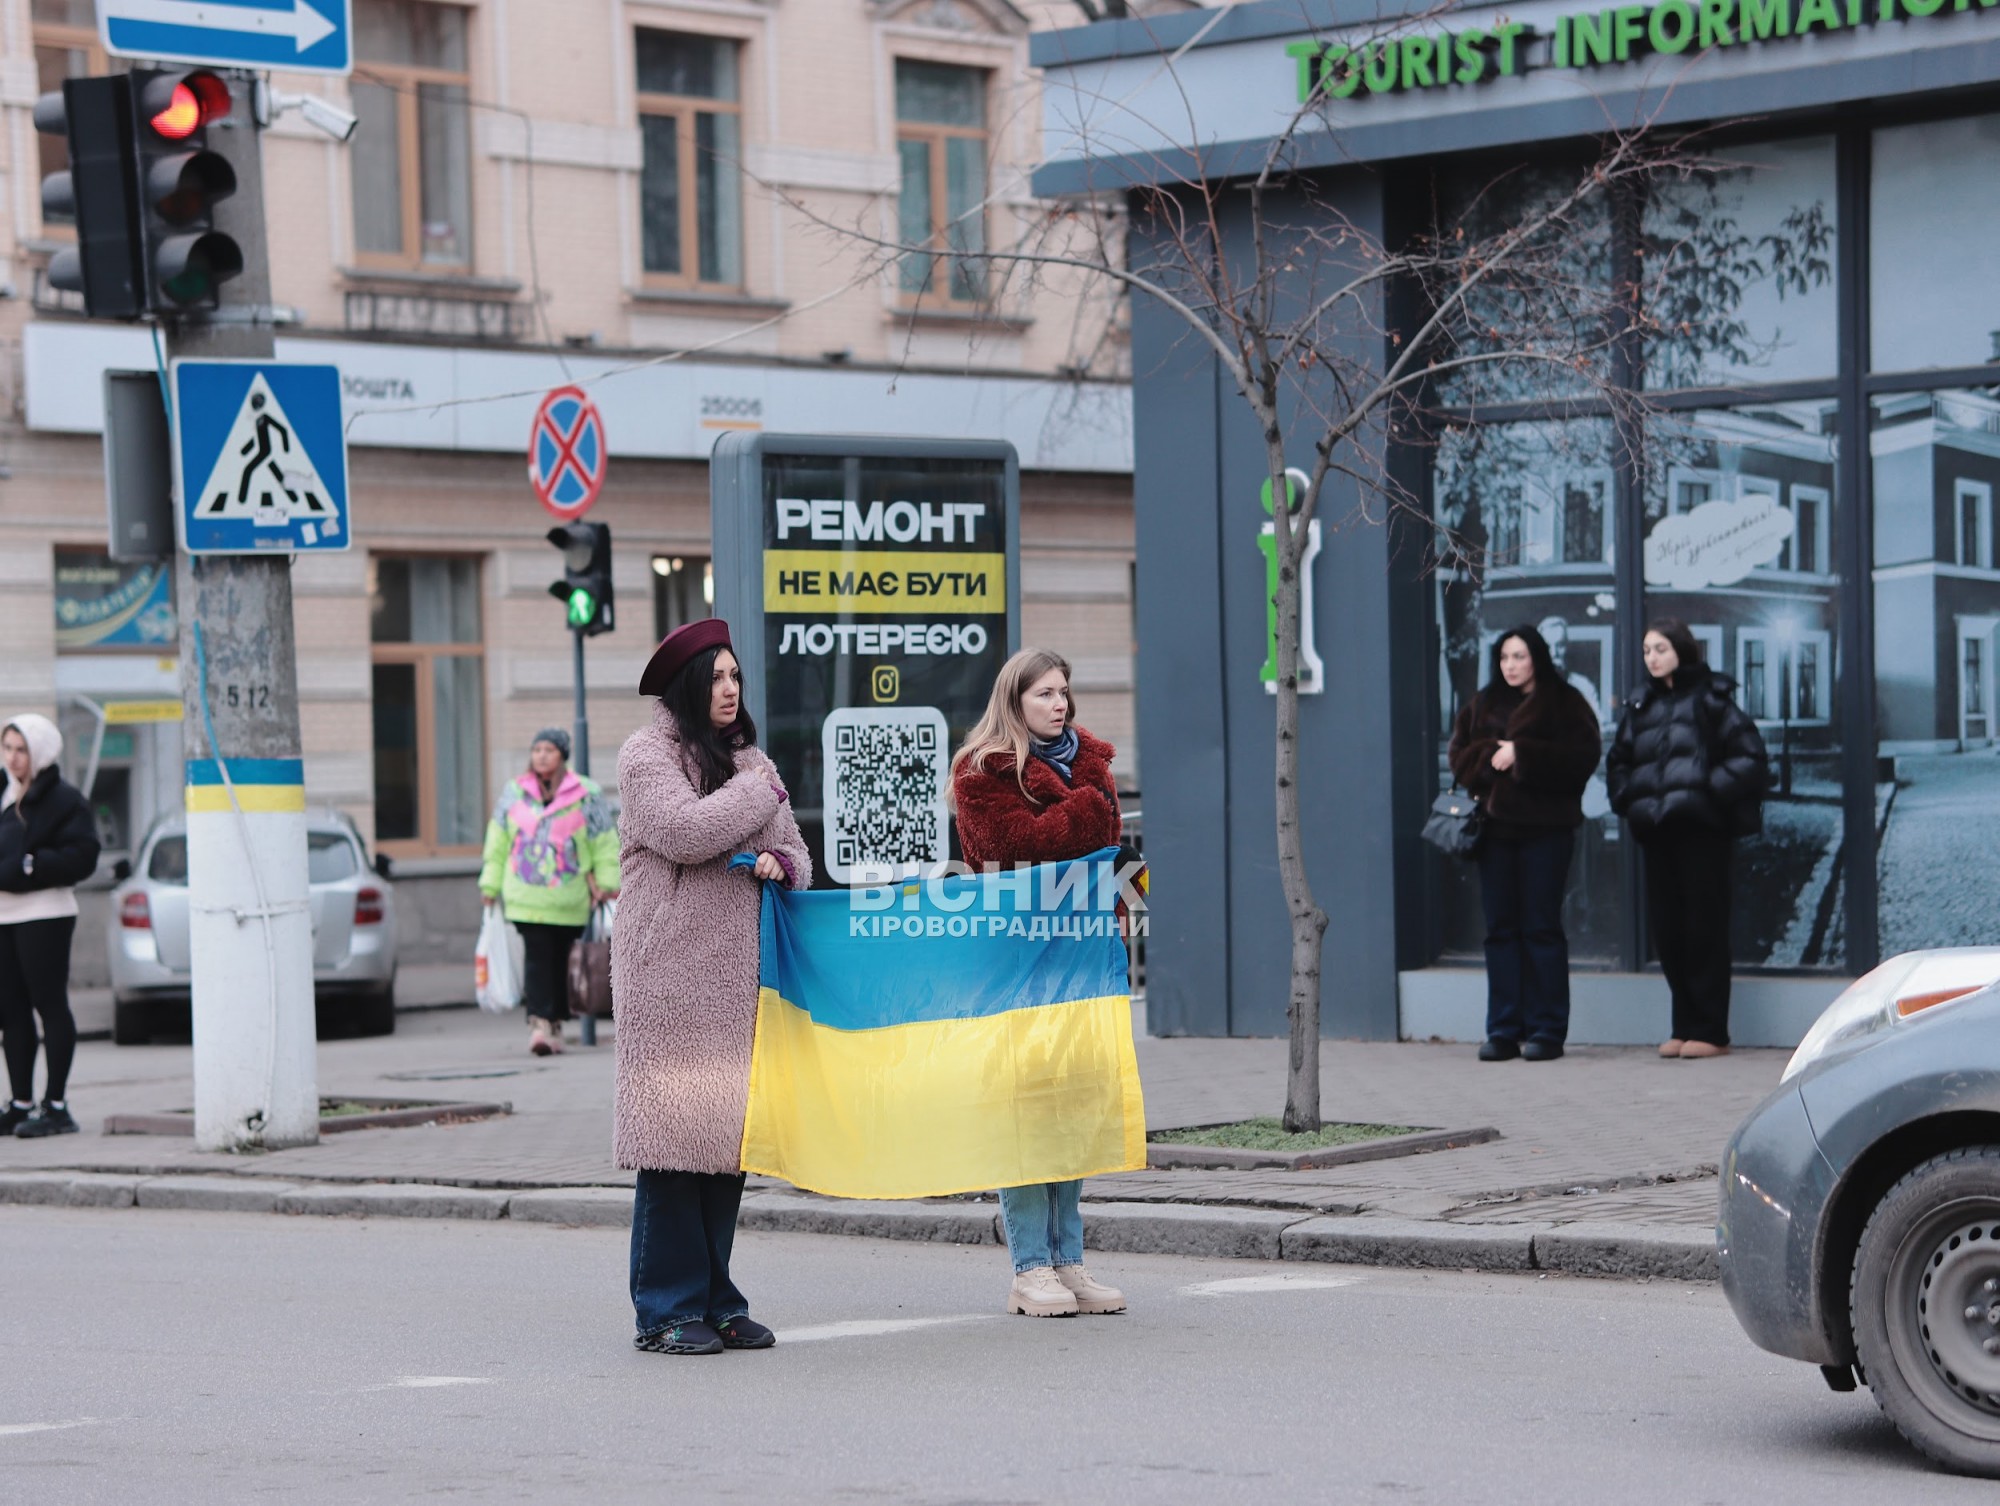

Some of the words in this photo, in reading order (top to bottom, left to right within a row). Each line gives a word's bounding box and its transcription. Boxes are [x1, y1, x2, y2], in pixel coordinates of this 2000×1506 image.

[1284, 24, 1525, 103] TOURIST
[1554, 0, 2000, 68] INFORMA
[776, 499, 986, 542] РЕМОНТ
[779, 571, 821, 595] НЕ
[829, 571, 899, 596] МАЄ
[907, 572, 986, 596] БУТИ
[779, 623, 987, 655] ЛОТЕРЕЄЮ
